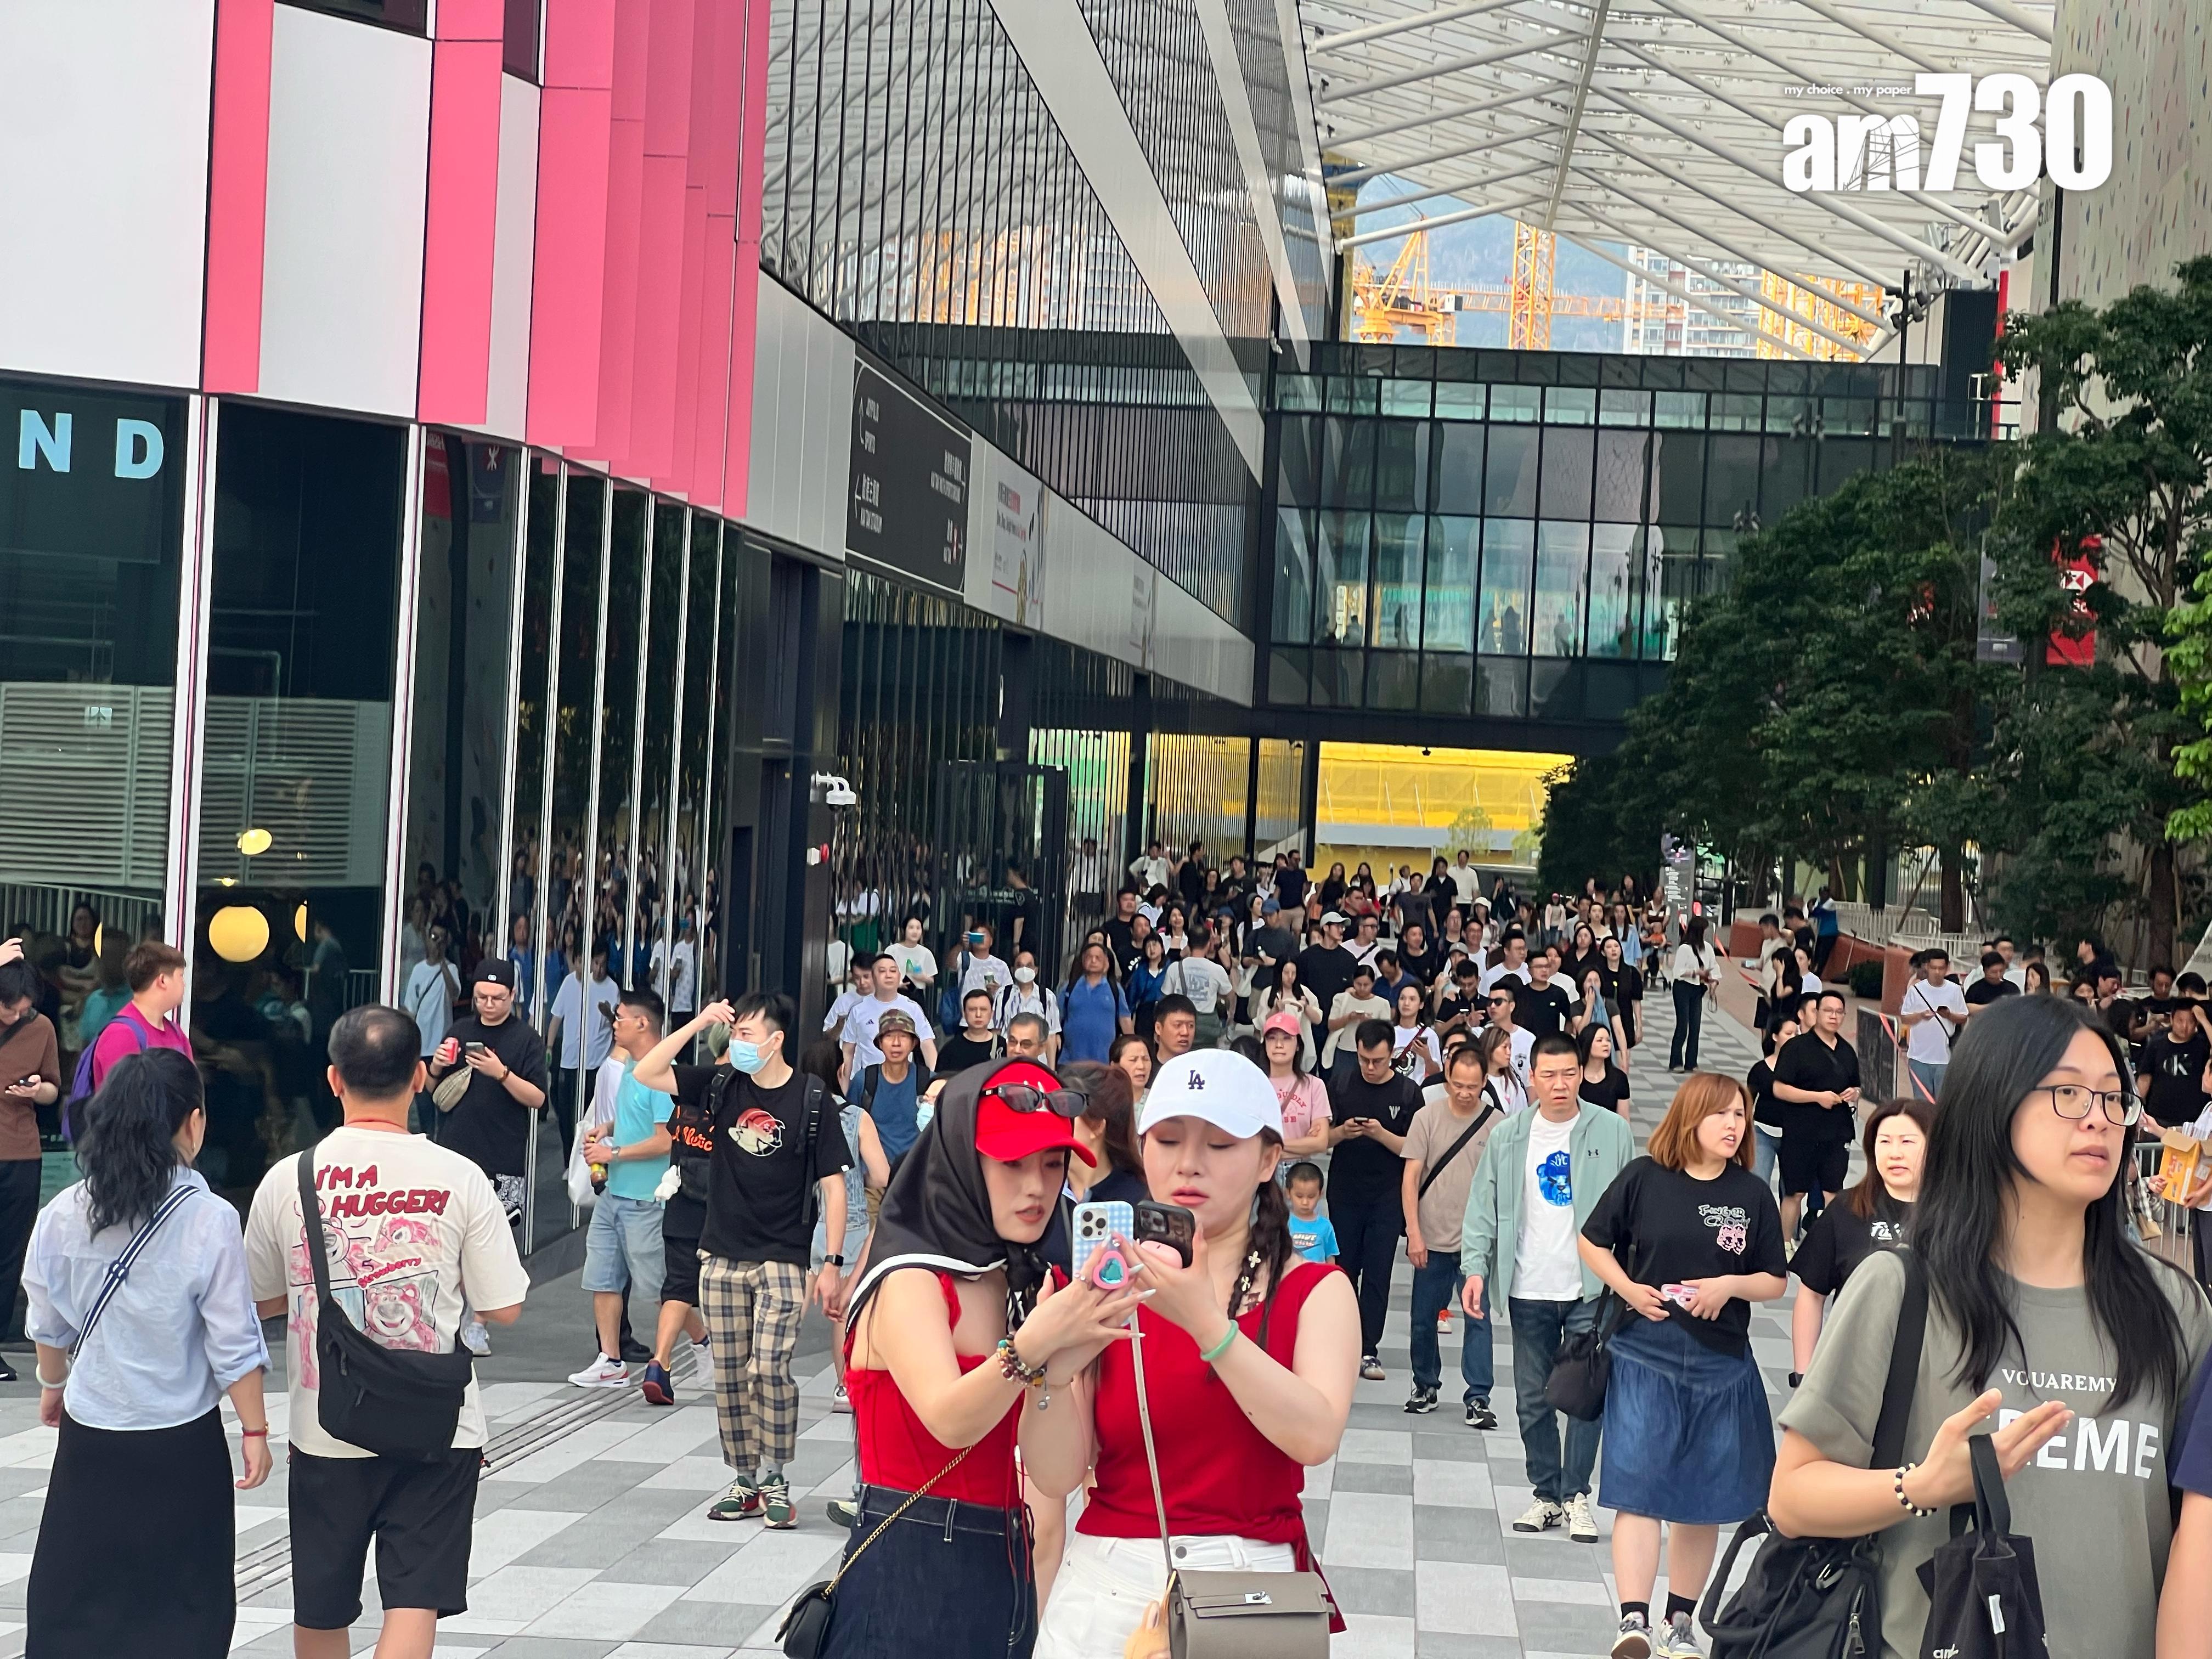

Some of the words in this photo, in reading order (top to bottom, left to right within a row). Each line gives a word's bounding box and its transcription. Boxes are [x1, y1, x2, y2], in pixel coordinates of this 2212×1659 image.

[1188, 1070, 1205, 1090] LA
[315, 1164, 353, 1191] I'M
[356, 1165, 377, 1188] A
[330, 1189, 450, 1218] HUGGER!
